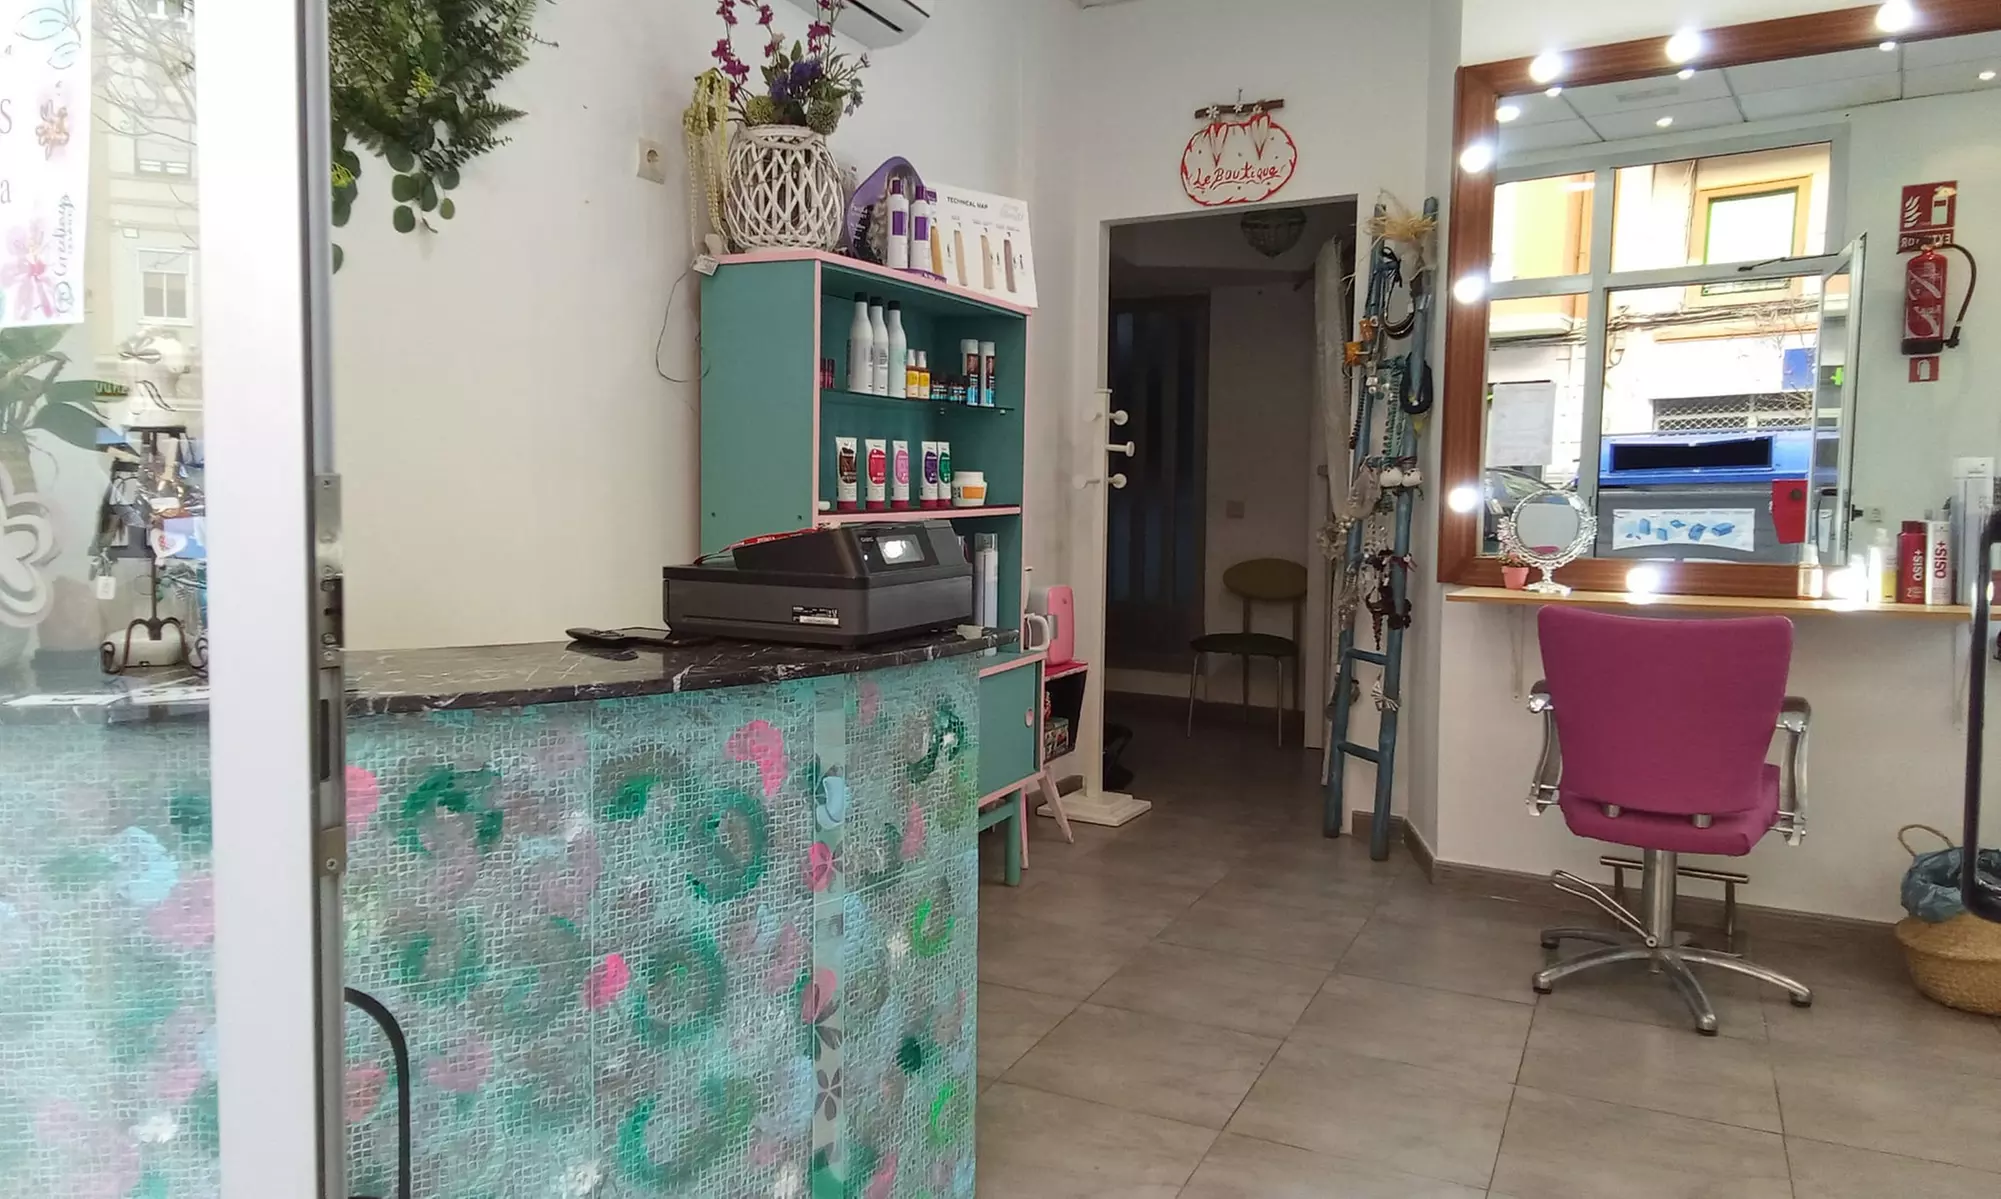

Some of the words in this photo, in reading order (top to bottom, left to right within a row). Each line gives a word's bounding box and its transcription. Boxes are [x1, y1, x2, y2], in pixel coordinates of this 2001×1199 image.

[1193, 168, 1211, 186] Le
[1211, 162, 1278, 186] Boutique
[946, 196, 977, 208] TECHNICAL
